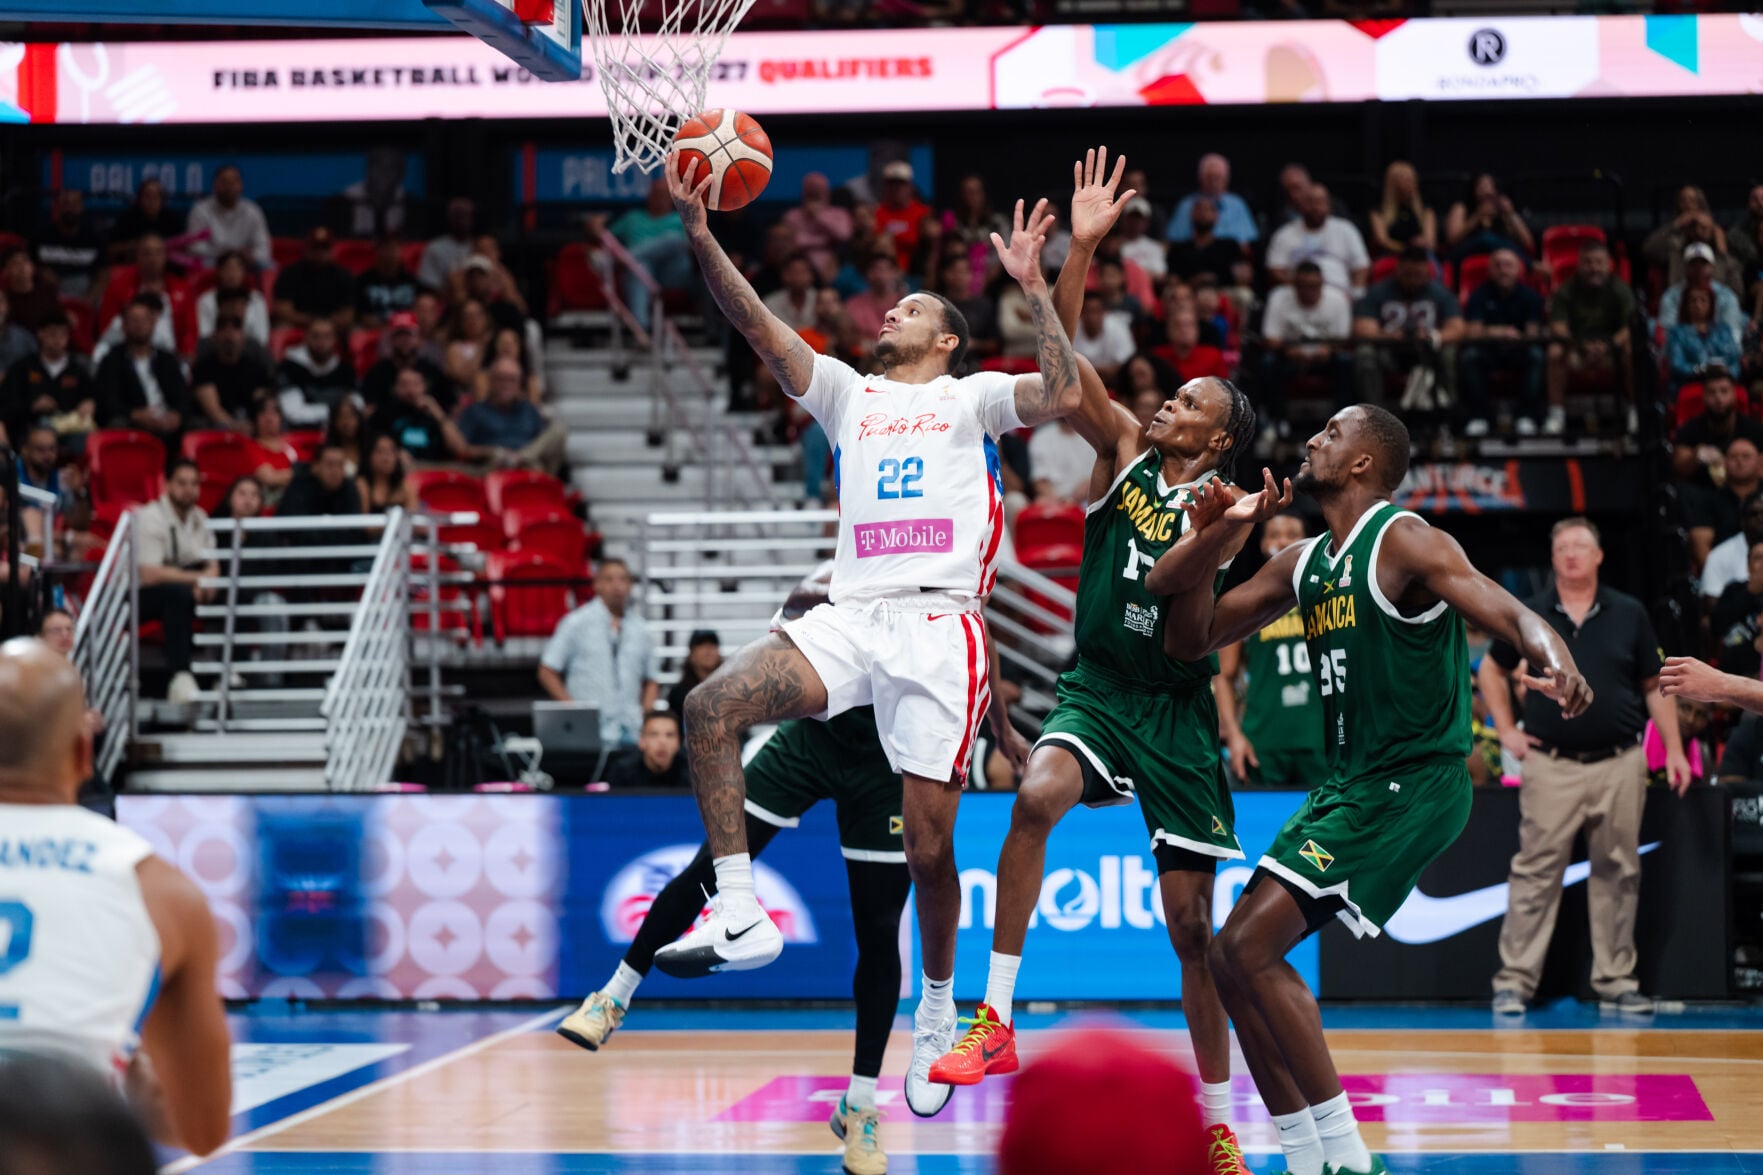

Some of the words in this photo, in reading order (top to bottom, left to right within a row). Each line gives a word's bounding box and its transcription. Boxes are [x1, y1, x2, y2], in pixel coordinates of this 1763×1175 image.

[213, 68, 279, 89] FIBA
[290, 66, 480, 88] BASKETBALL
[493, 65, 593, 84] WOD
[759, 57, 933, 83] QUALIFIERS
[910, 413, 951, 438] Rico
[878, 456, 923, 500] 22
[1117, 481, 1175, 542] JAMAIC
[879, 526, 947, 550] Mobile
[1124, 609, 1156, 628] MARLEY
[1276, 641, 1312, 675] 10
[956, 855, 1256, 932] moltn
